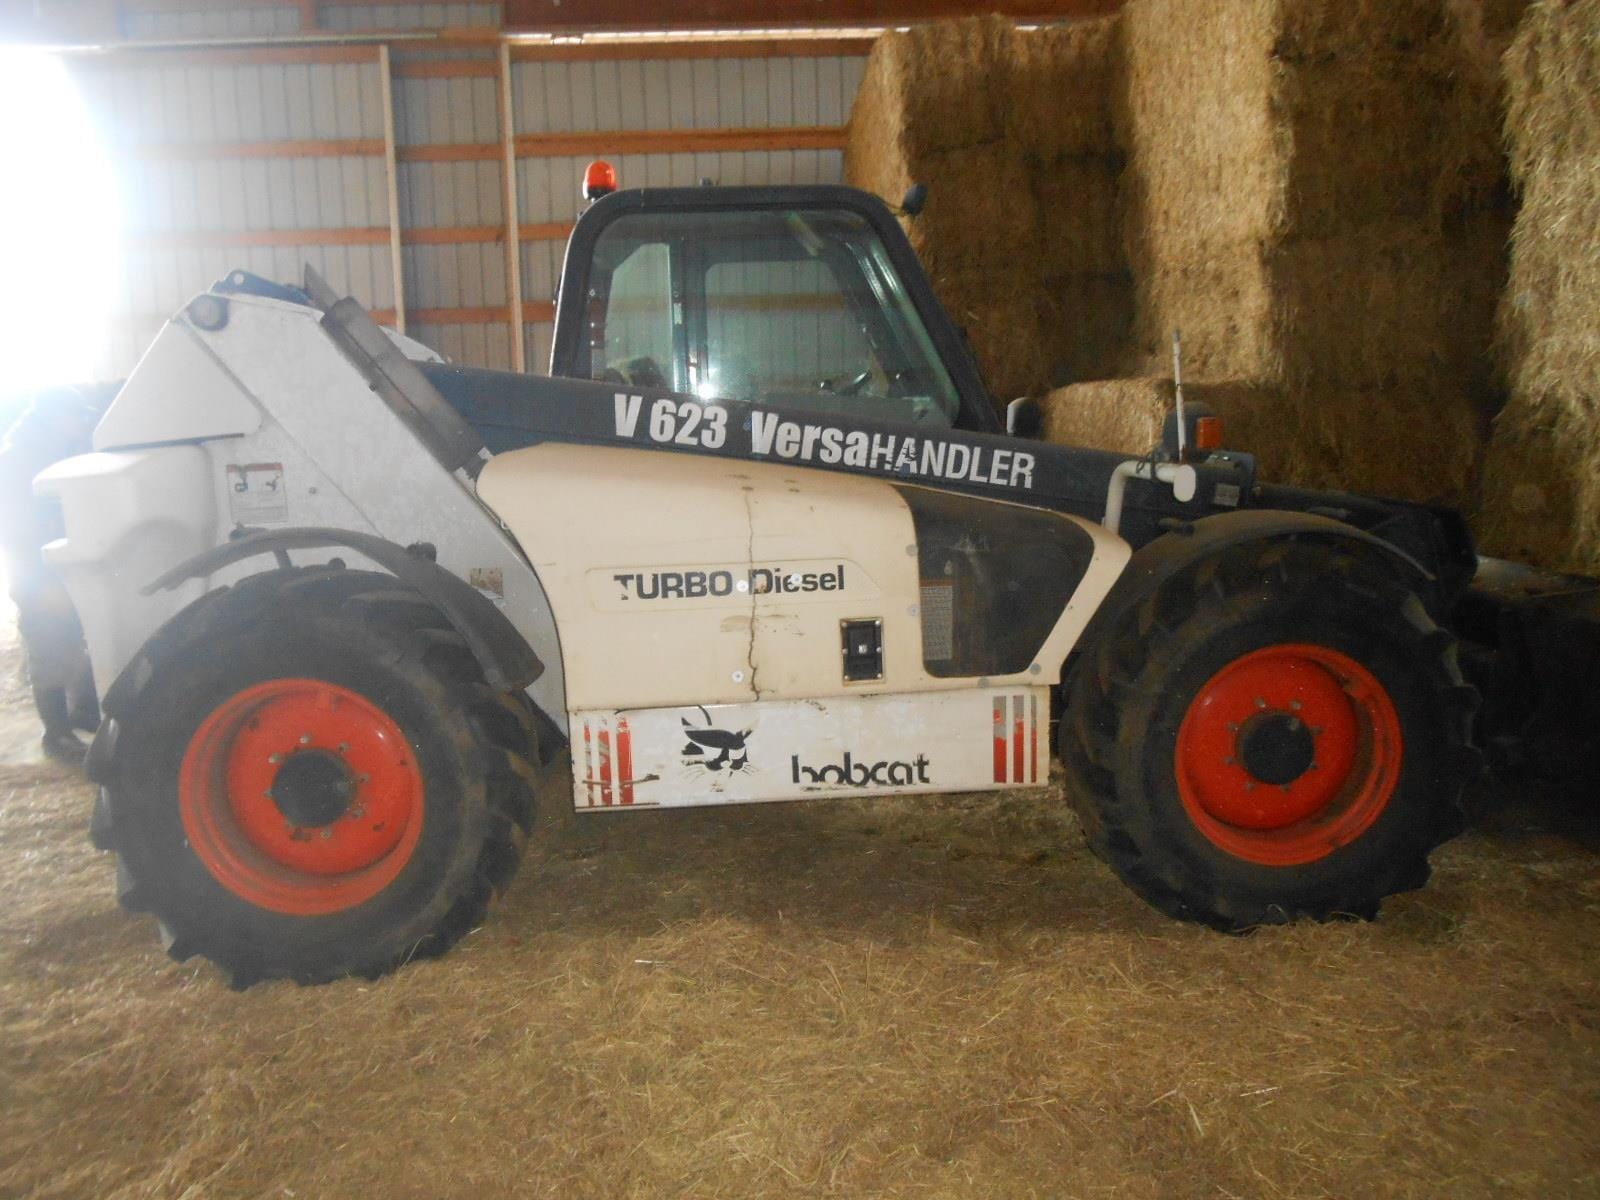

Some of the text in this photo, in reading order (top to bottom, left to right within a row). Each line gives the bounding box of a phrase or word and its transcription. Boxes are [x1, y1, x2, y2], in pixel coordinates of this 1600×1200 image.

[614, 393, 643, 437] V
[649, 400, 727, 449] 623
[613, 565, 845, 600] TURBO Diesel
